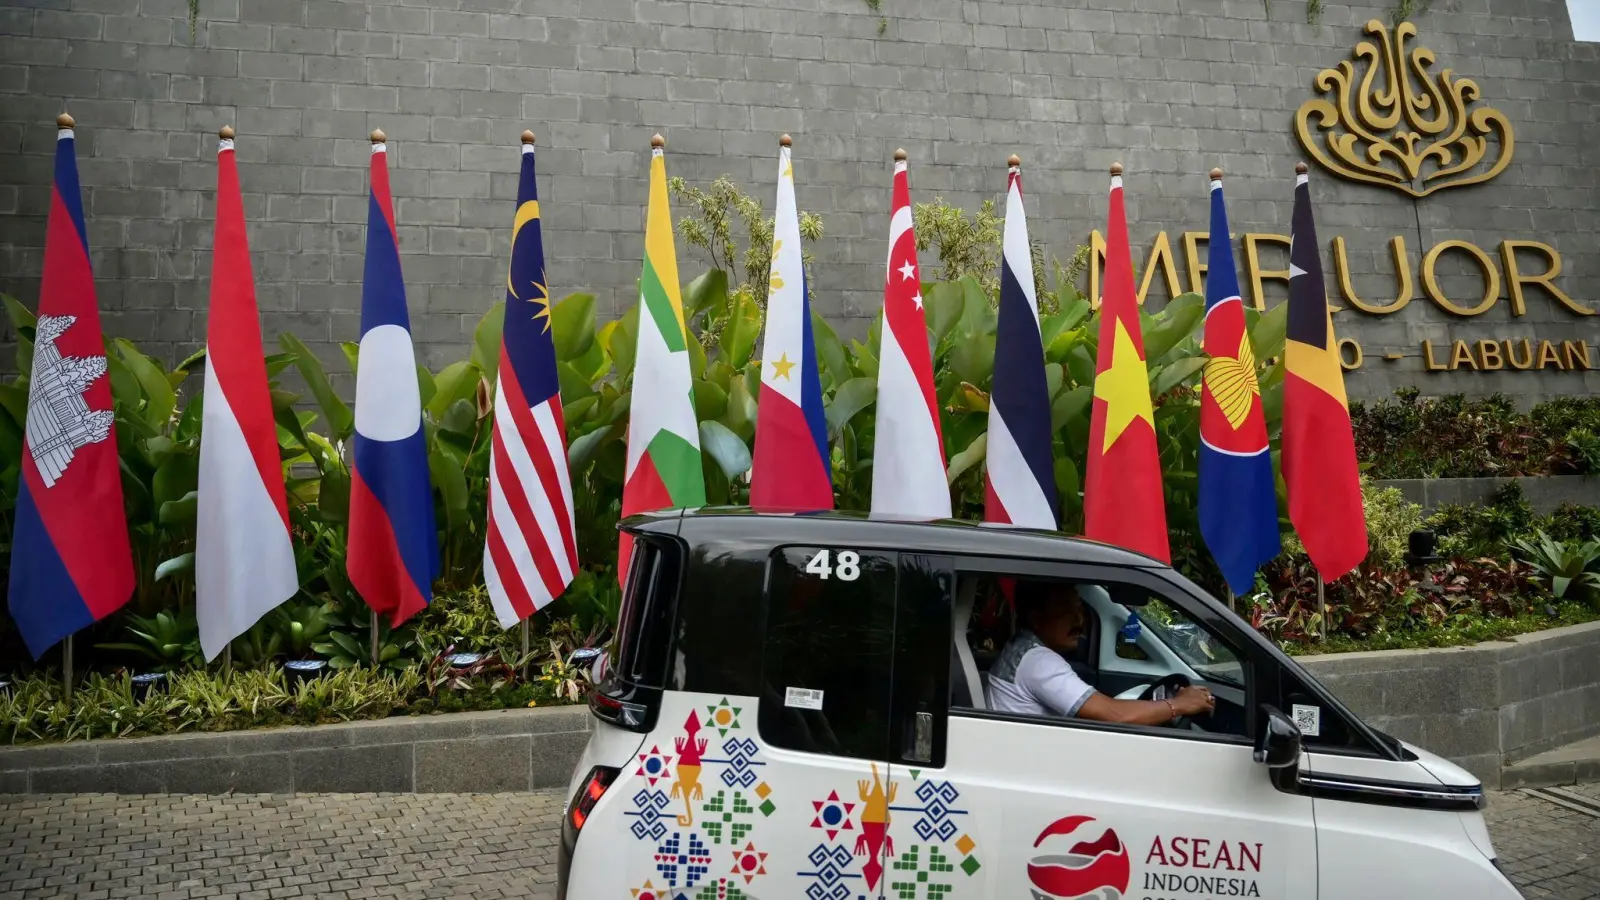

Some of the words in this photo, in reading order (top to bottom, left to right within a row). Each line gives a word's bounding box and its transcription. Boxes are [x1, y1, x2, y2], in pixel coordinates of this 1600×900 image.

[1422, 339, 1592, 371] LABUAN
[806, 549, 861, 581] 48
[1145, 835, 1263, 872] ASEAN
[1142, 872, 1261, 898] INDONESIA
